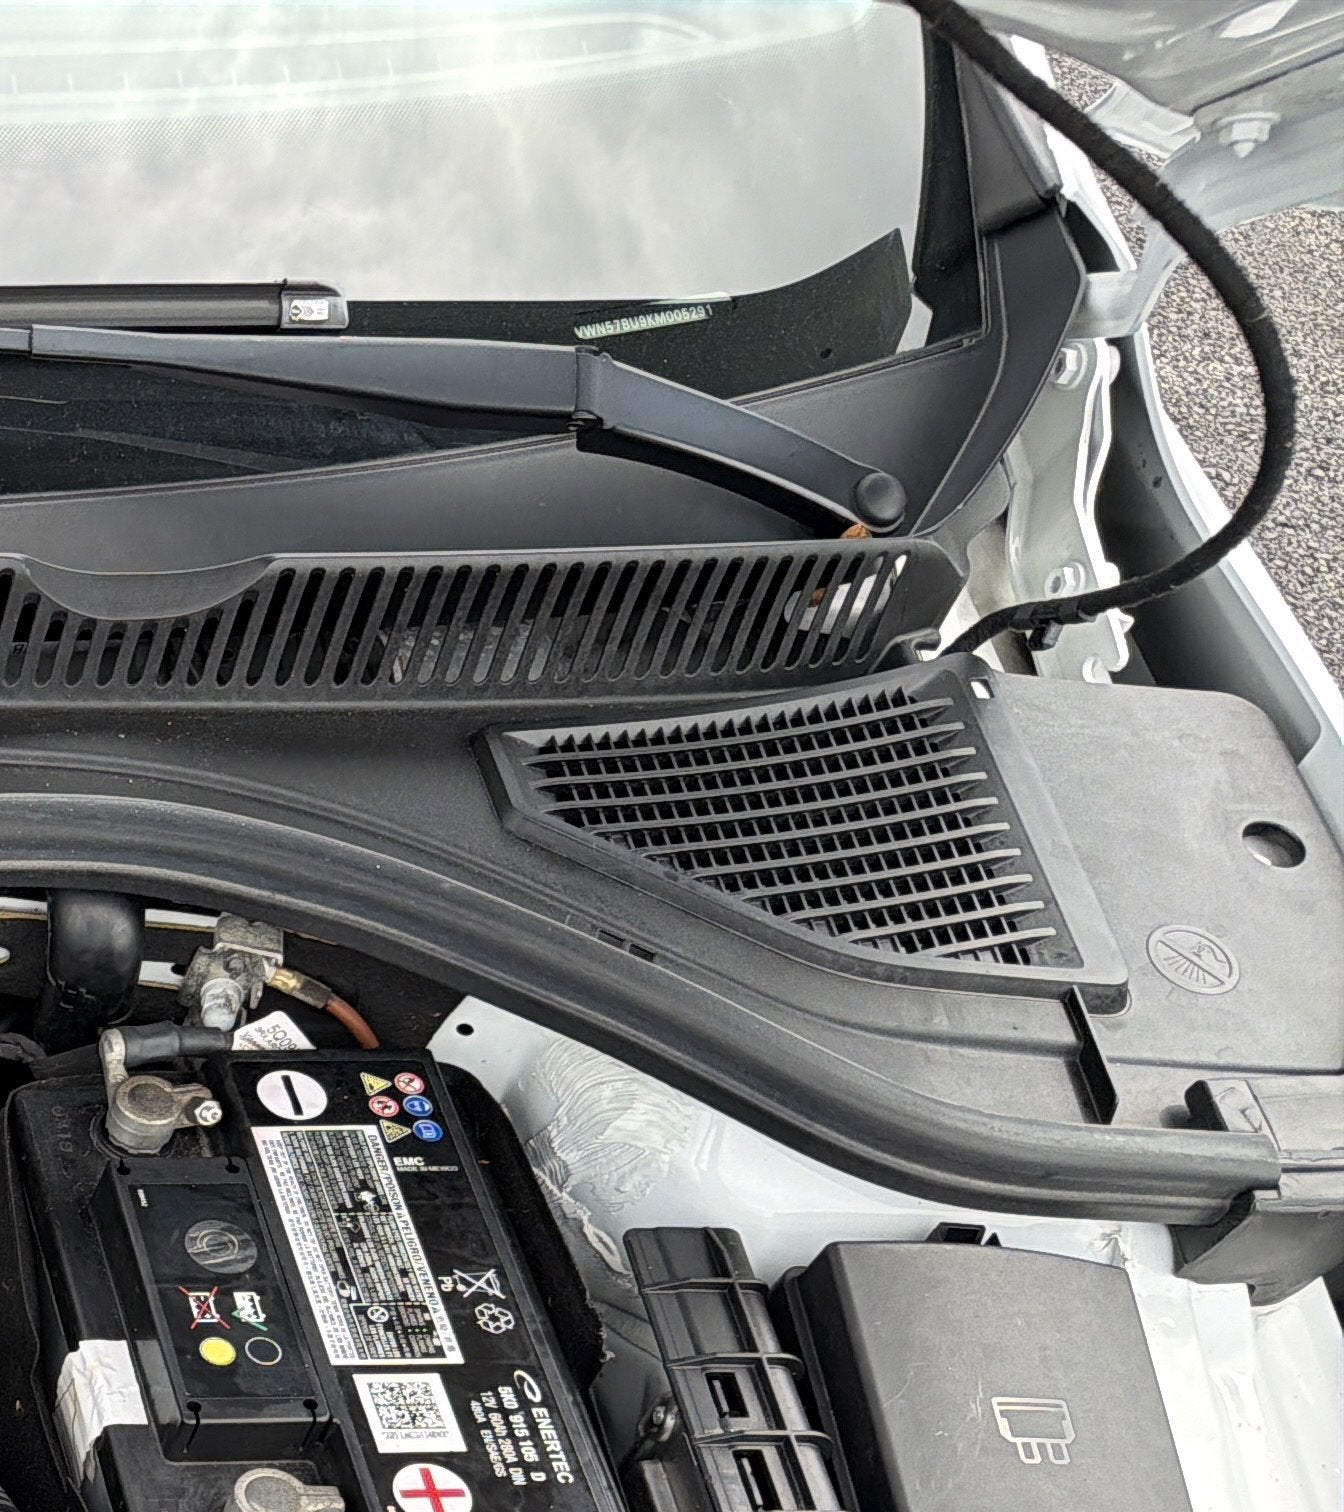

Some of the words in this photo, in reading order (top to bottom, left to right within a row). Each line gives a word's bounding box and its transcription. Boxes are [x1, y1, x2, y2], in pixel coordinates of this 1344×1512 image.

[392, 1156, 425, 1167] EMC
[437, 1276, 454, 1292] Pb
[509, 1412, 530, 1438] 915
[479, 1390, 499, 1409] 12V
[498, 1438, 519, 1464] 280A
[509, 1467, 527, 1486] DIN
[530, 1407, 575, 1485] ENERTEC
[518, 1440, 540, 1463] 105
[529, 1471, 547, 1482] D
